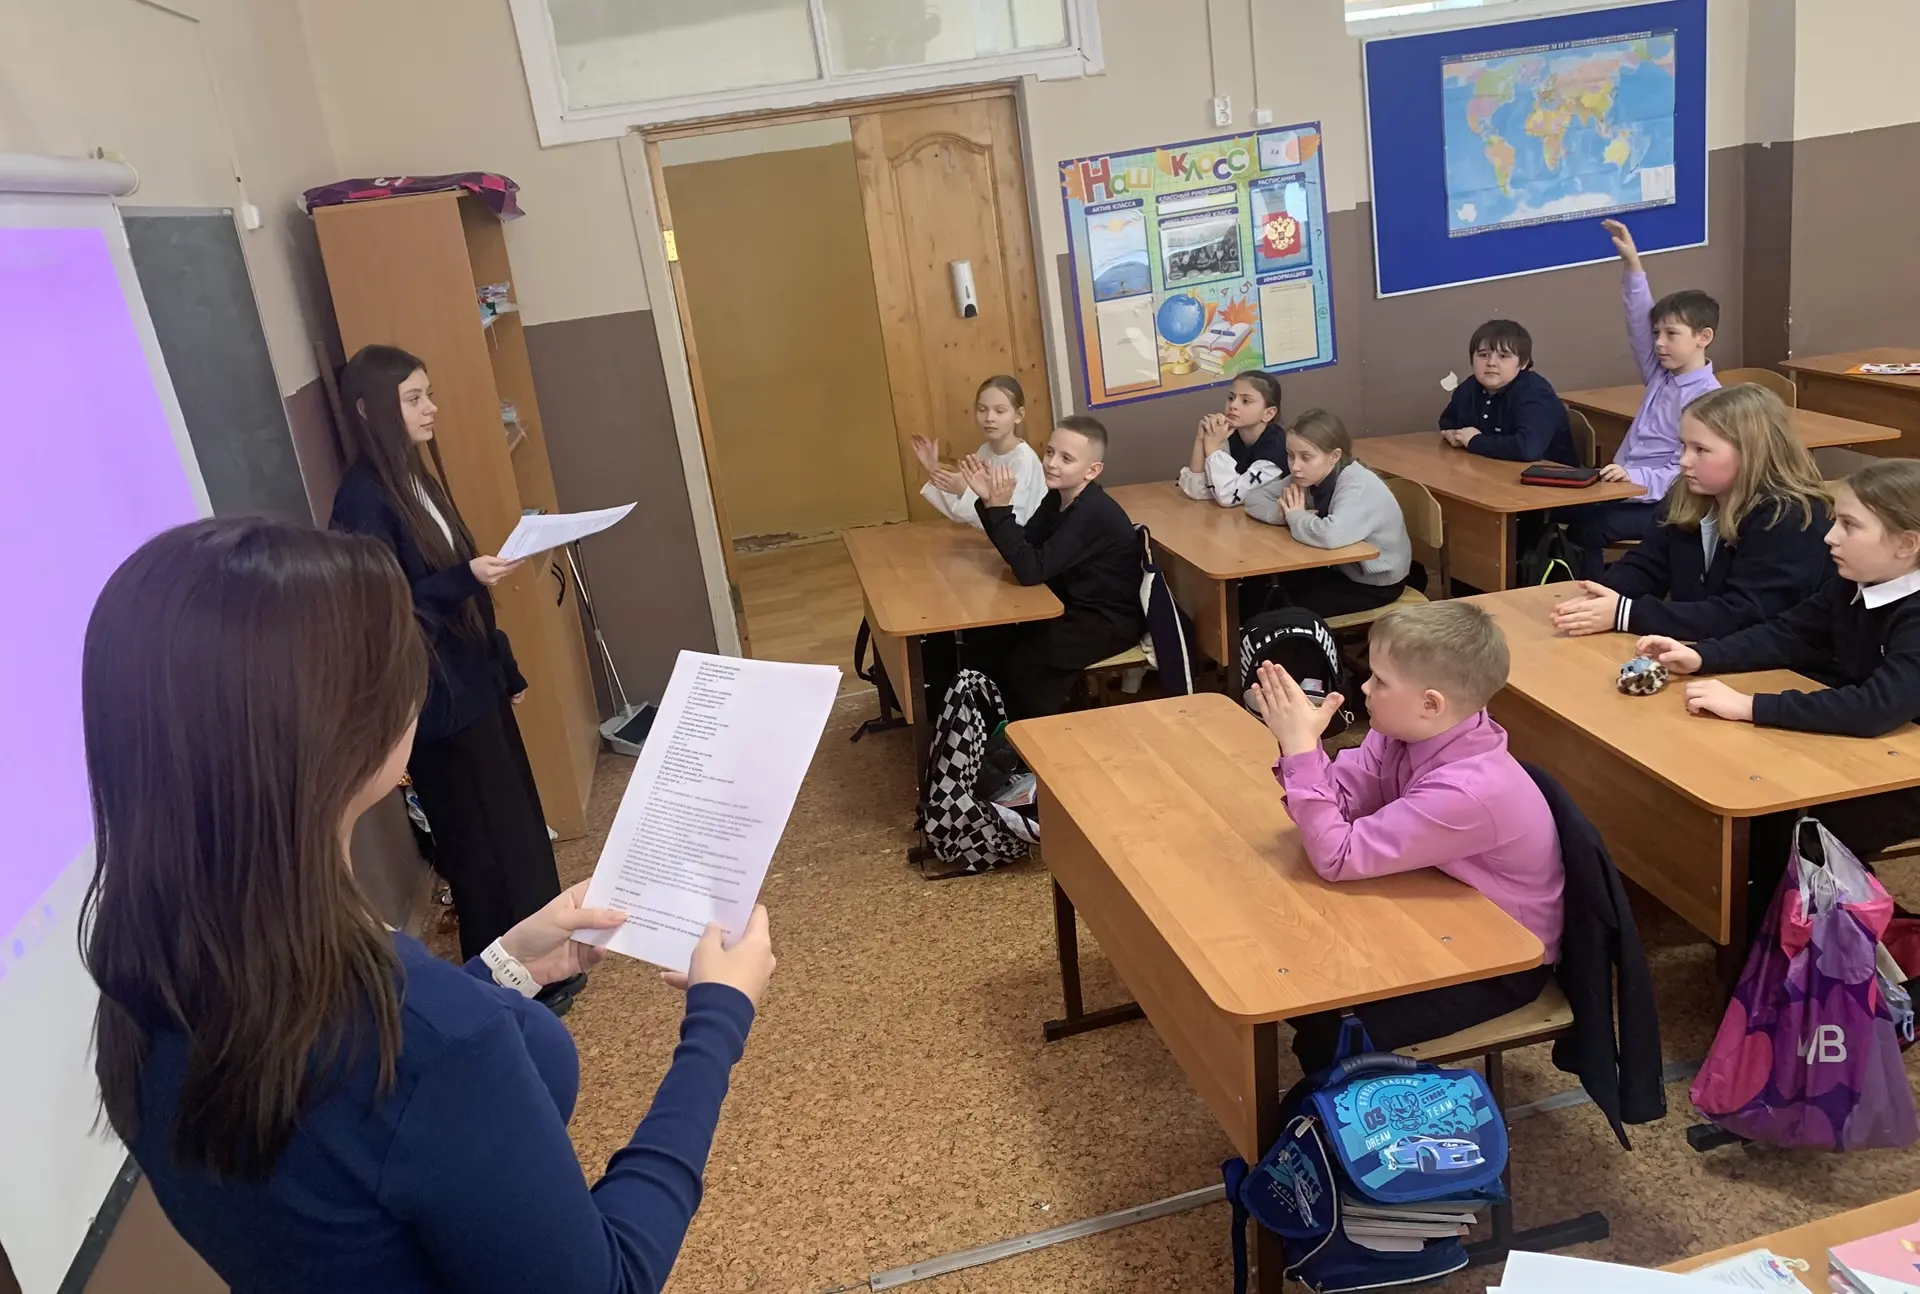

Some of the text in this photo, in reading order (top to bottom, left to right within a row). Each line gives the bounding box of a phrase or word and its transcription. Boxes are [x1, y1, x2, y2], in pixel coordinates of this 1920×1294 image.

[1080, 157, 1153, 204] Наш
[1257, 174, 1296, 185] РАСПИСАНИЕ
[1092, 200, 1137, 213] АКТИВ КЛАССА
[1263, 270, 1307, 283] ИНФОРМАЦИЯ
[1359, 1078, 1420, 1106] STREET RACING
[1426, 1099, 1453, 1119] TEAM
[1365, 1130, 1392, 1150] DREAM
[1267, 1185, 1293, 1214] TEAM
